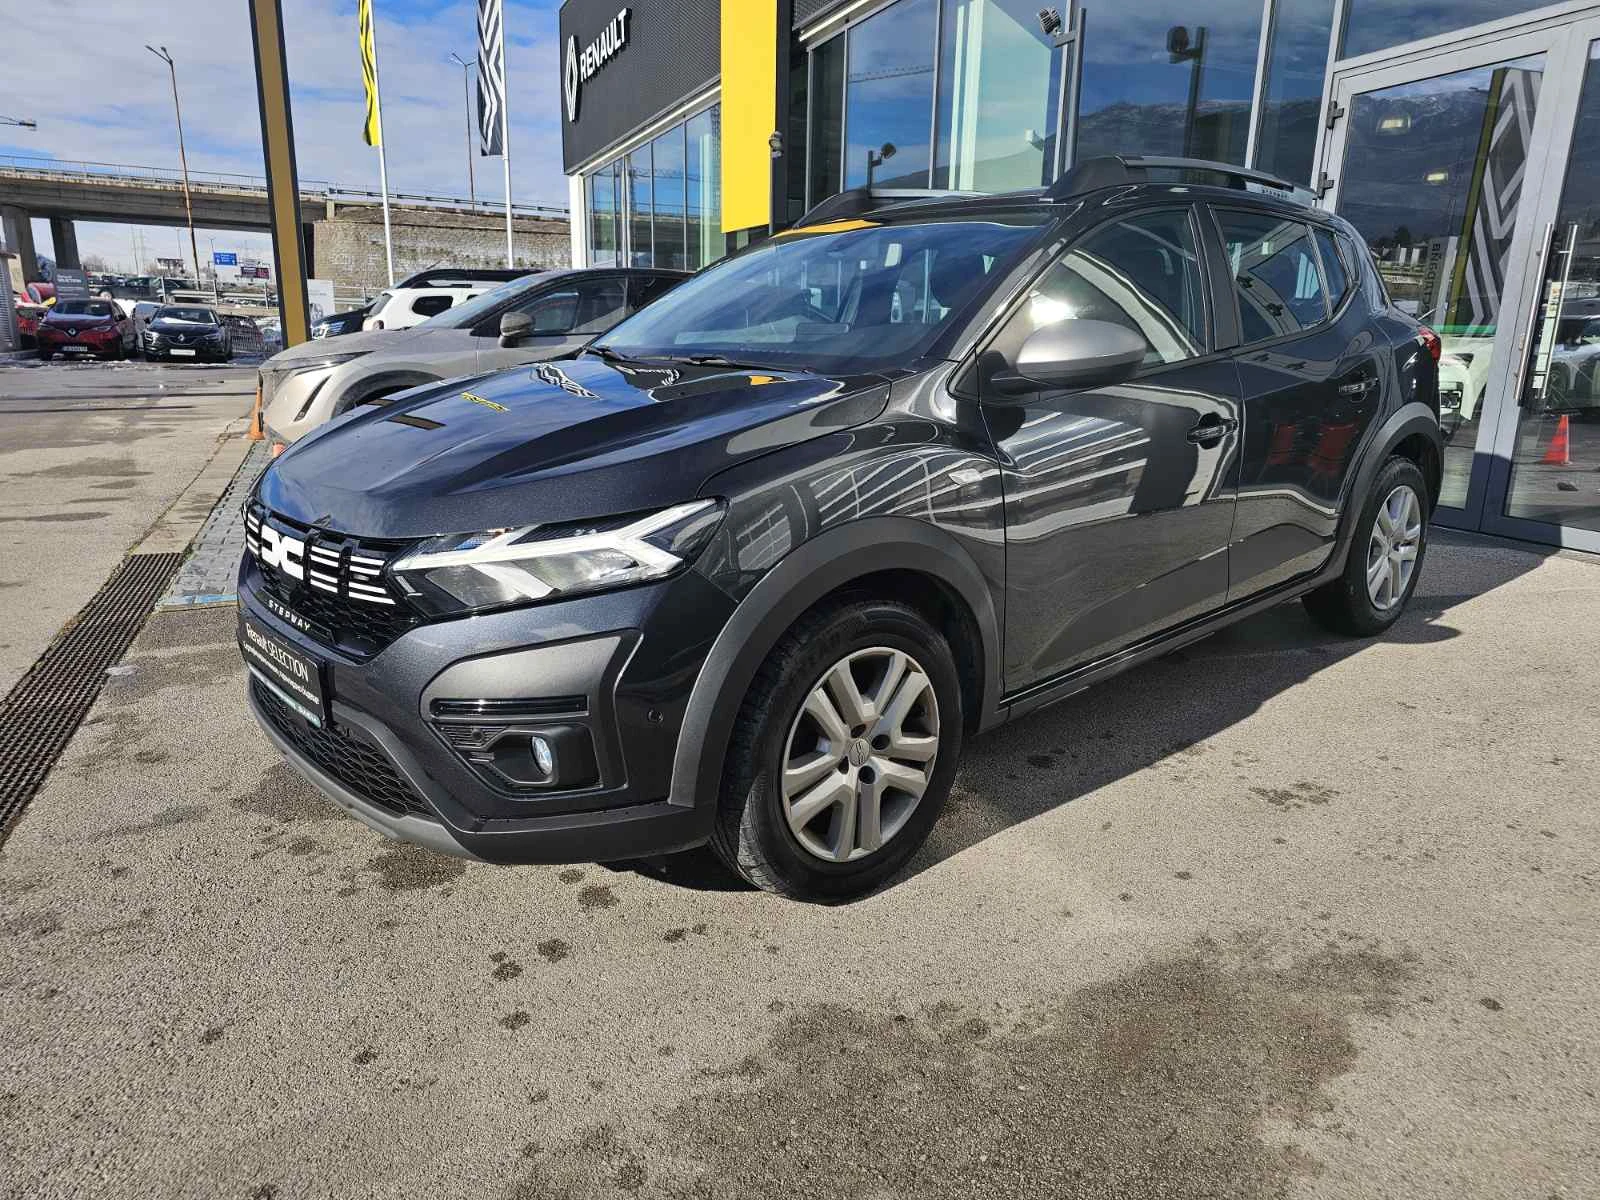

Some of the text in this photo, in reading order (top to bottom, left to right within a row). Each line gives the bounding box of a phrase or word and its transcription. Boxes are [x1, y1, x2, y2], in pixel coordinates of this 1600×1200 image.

[580, 8, 627, 83] RENAULT
[268, 599, 311, 631] STEPWAY
[267, 639, 309, 682] SELECTION
